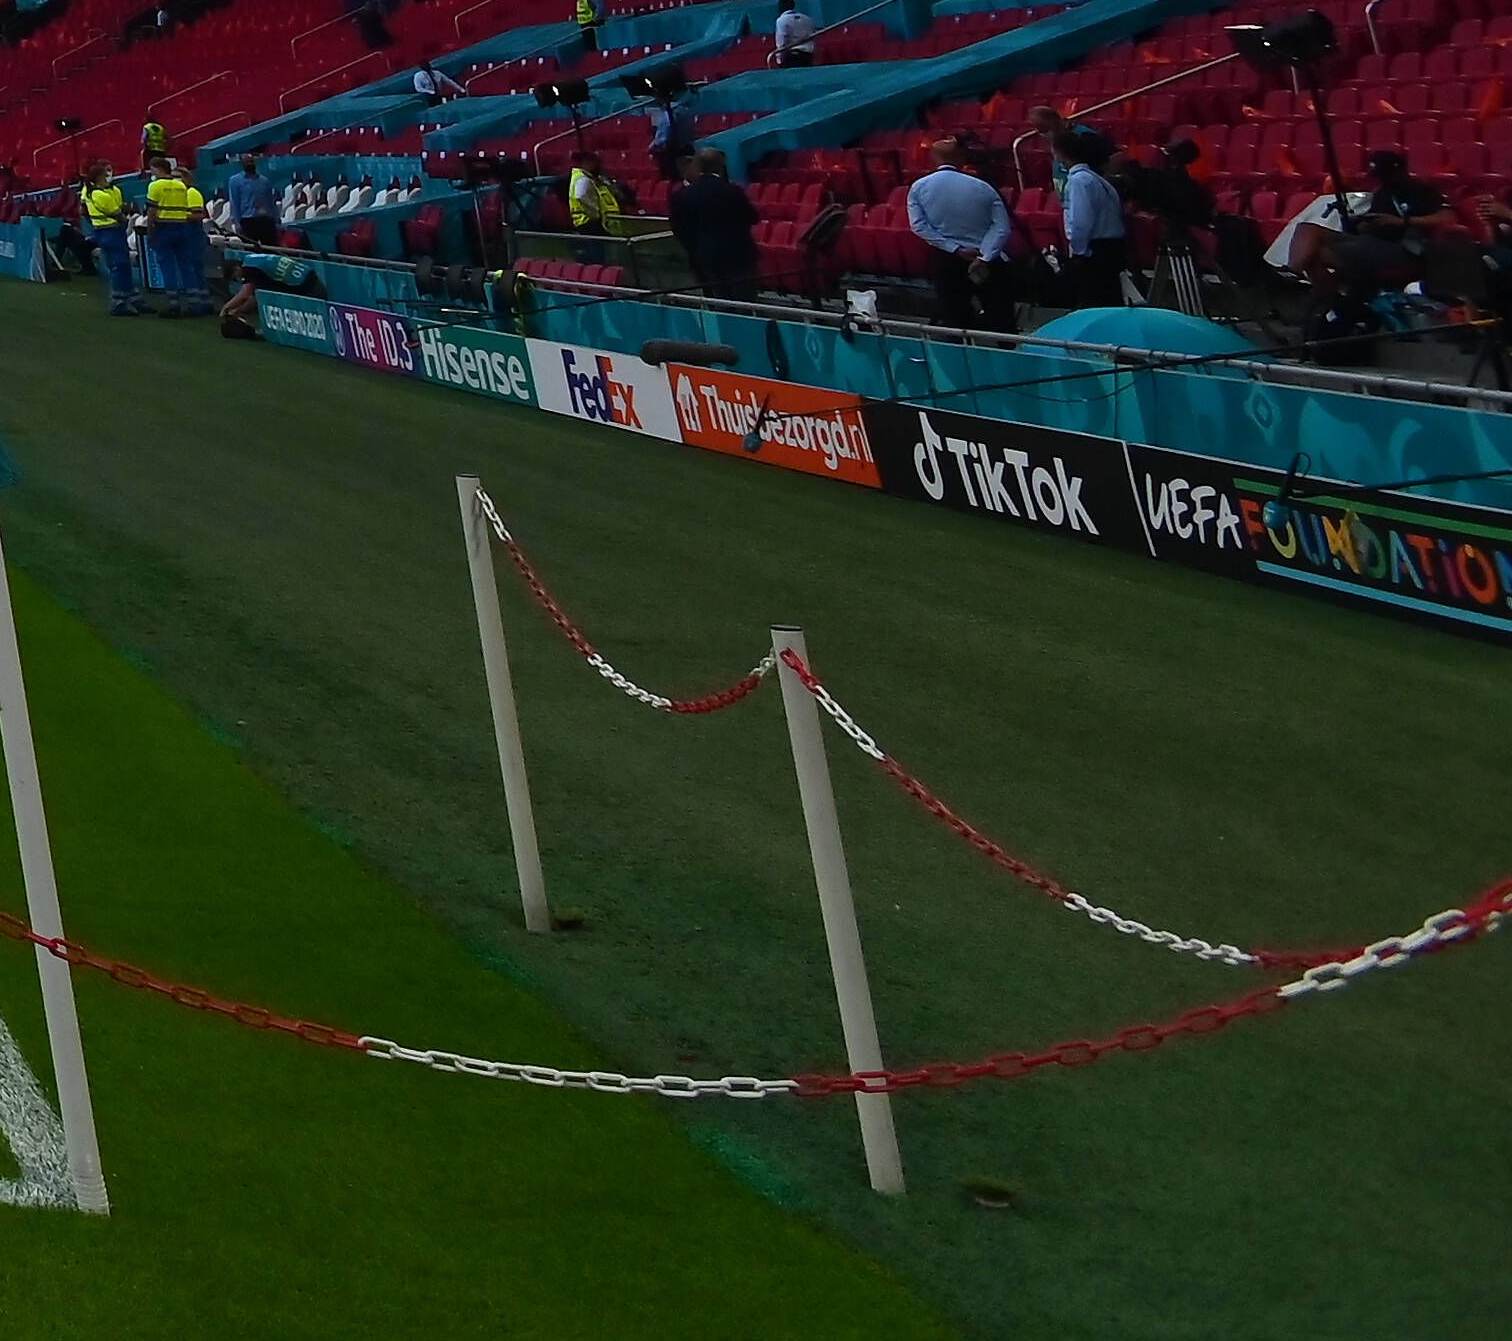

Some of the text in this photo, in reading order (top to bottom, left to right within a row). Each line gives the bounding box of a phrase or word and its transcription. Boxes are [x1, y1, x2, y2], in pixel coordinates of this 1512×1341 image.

[345, 313, 378, 362] The
[376, 316, 414, 371] ID.3
[418, 324, 530, 400] Hisense
[561, 348, 643, 429] FedEx
[945, 437, 1100, 535] TikTok
[1145, 473, 1243, 549] UEFA
